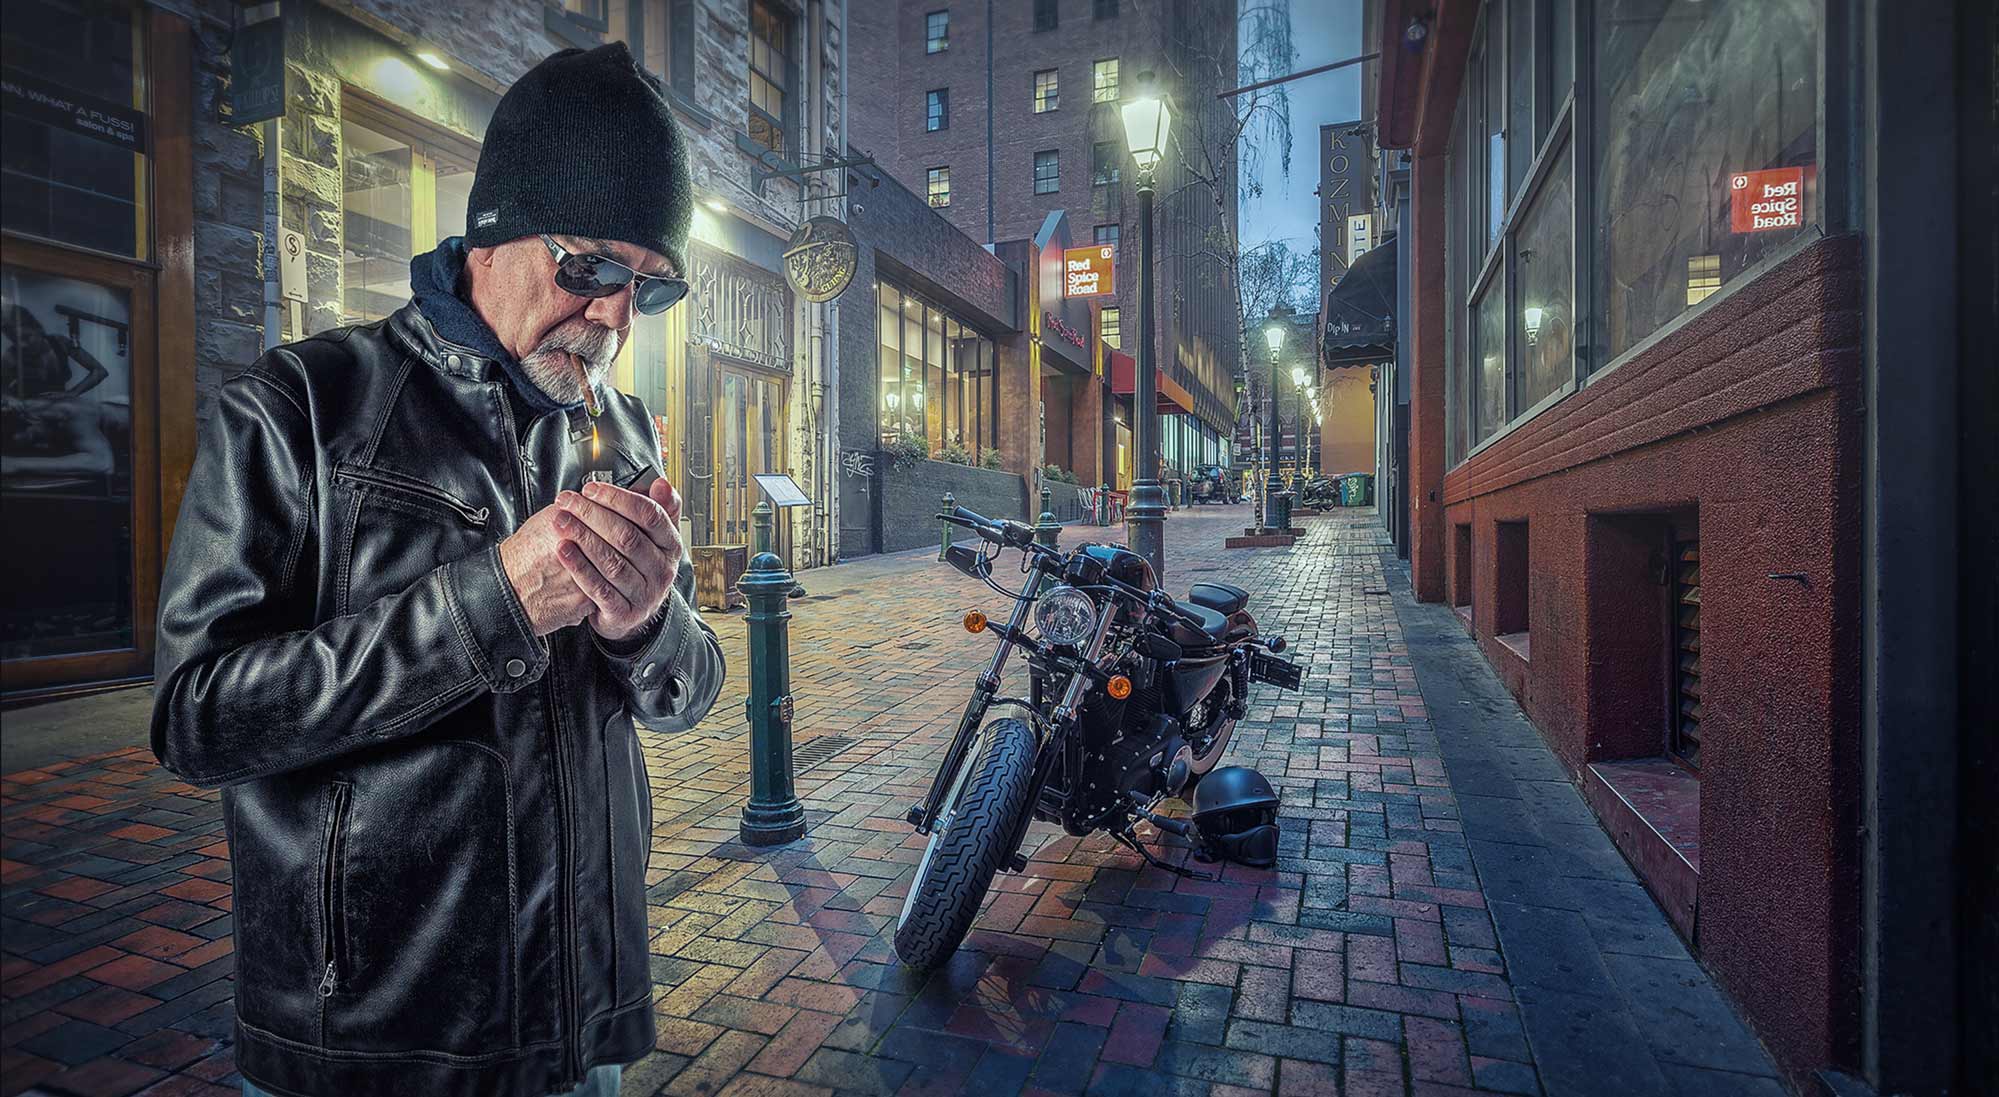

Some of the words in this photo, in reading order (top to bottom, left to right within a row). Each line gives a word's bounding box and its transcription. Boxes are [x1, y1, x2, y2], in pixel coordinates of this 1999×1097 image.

[27, 89, 74, 112] WHAT
[75, 106, 87, 118] A
[75, 118, 105, 134] salon
[106, 128, 114, 136] &
[116, 131, 135, 143] spa
[1067, 259, 1091, 272] Red
[1067, 271, 1099, 285] Spice
[1067, 282, 1098, 296] Road
